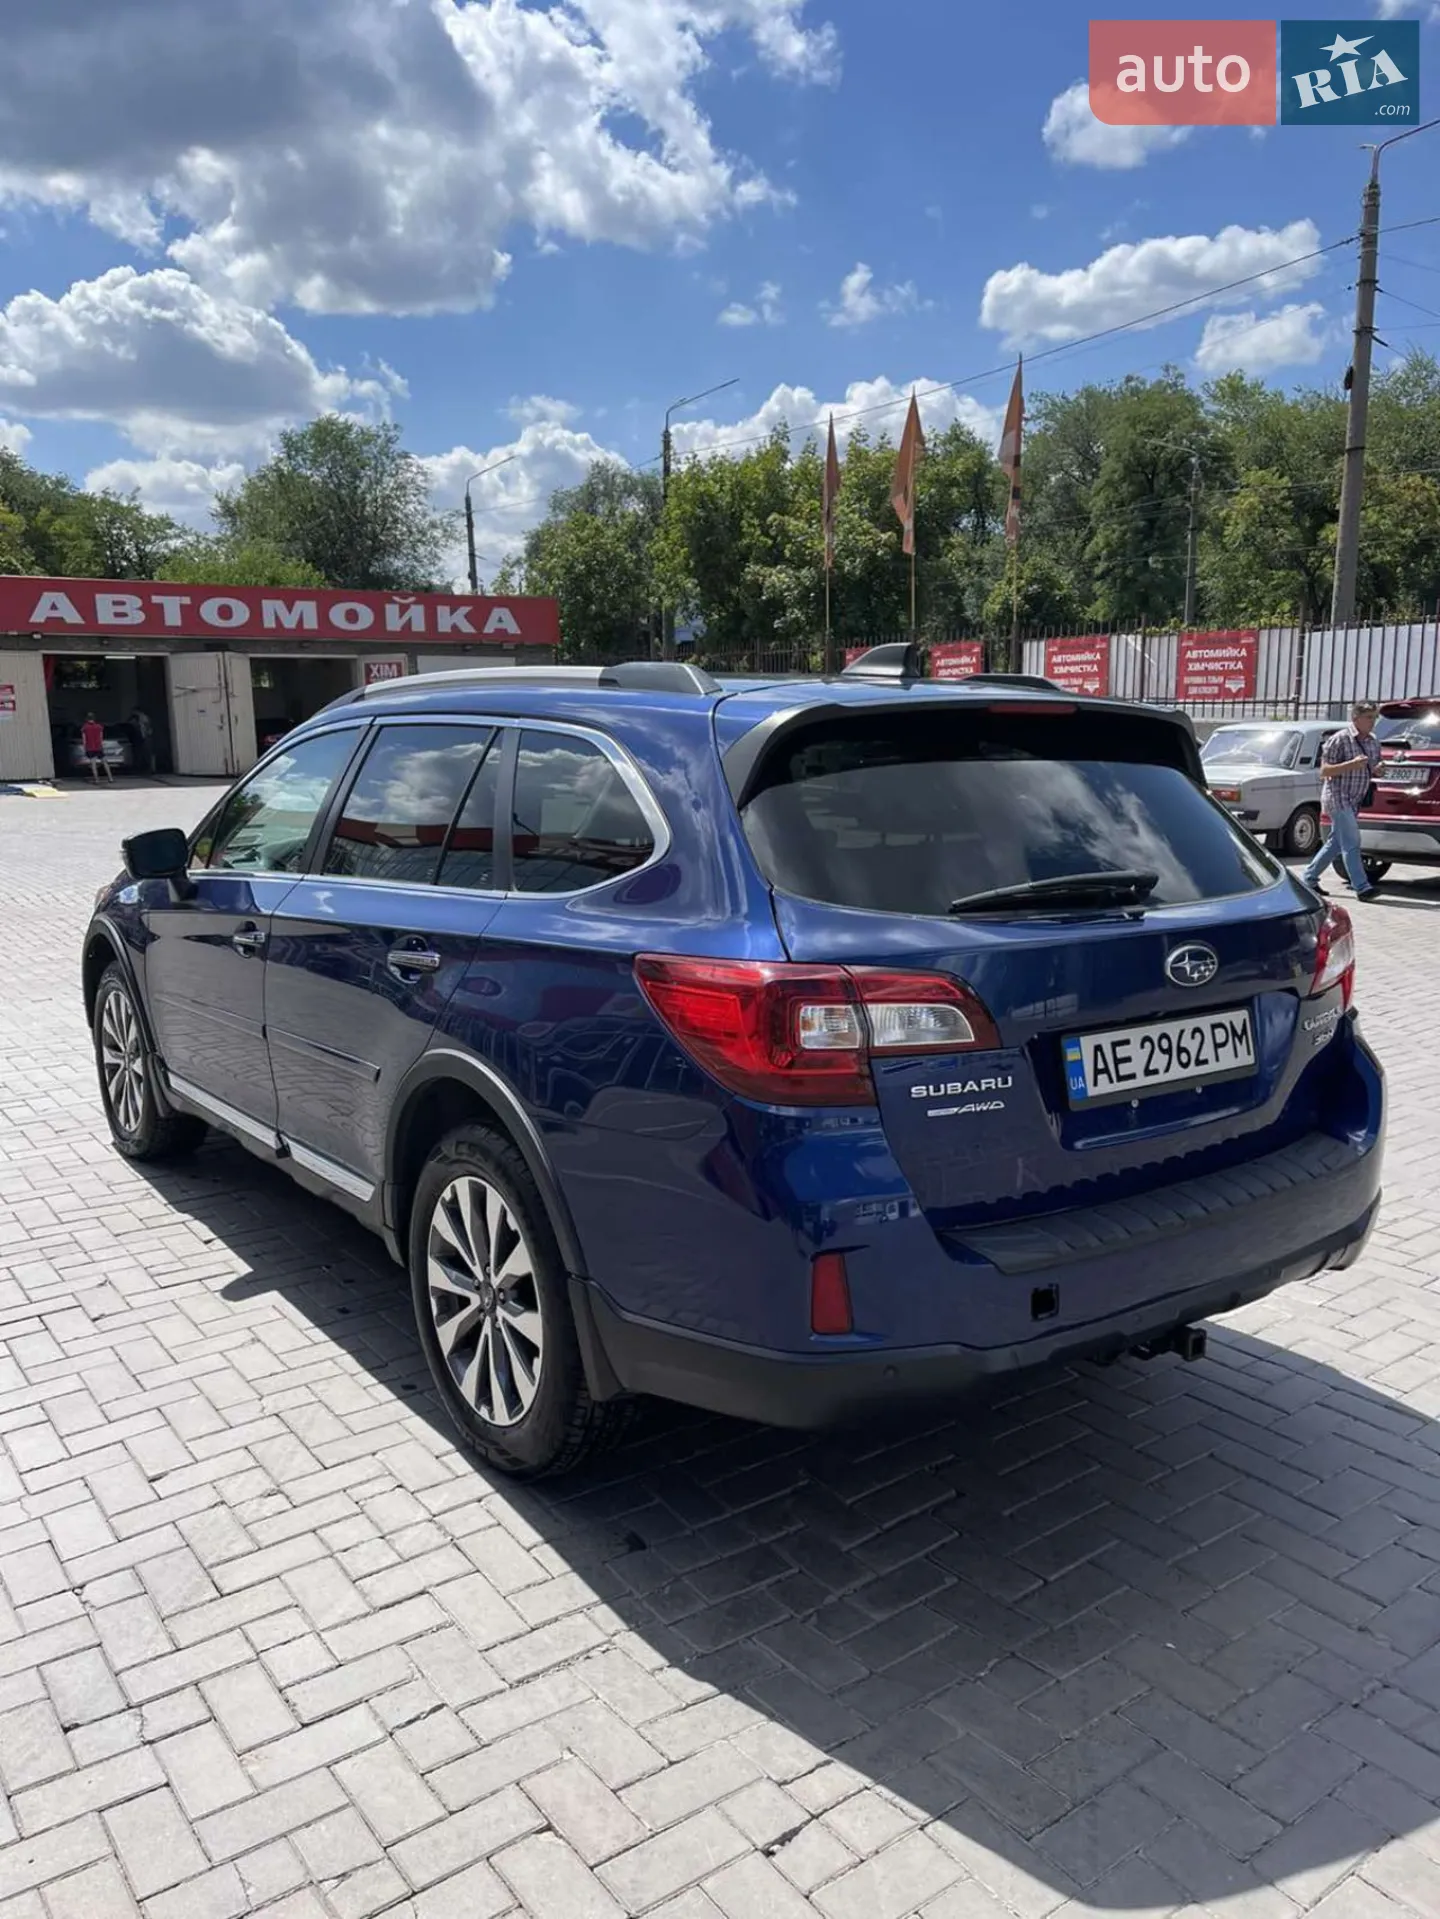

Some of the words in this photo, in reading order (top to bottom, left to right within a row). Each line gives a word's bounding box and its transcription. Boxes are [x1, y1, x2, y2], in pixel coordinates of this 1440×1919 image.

[28, 590, 522, 635] АВТОМОЙКА
[1185, 647, 1247, 658] АВТОМИЙКА
[1092, 1038, 1137, 1088] AE
[1140, 1026, 1209, 1078] 2962
[1210, 1018, 1252, 1063] PM
[910, 1075, 1013, 1099] SUBARU
[1069, 1076, 1086, 1091] UA
[957, 1100, 1005, 1114] AWD
